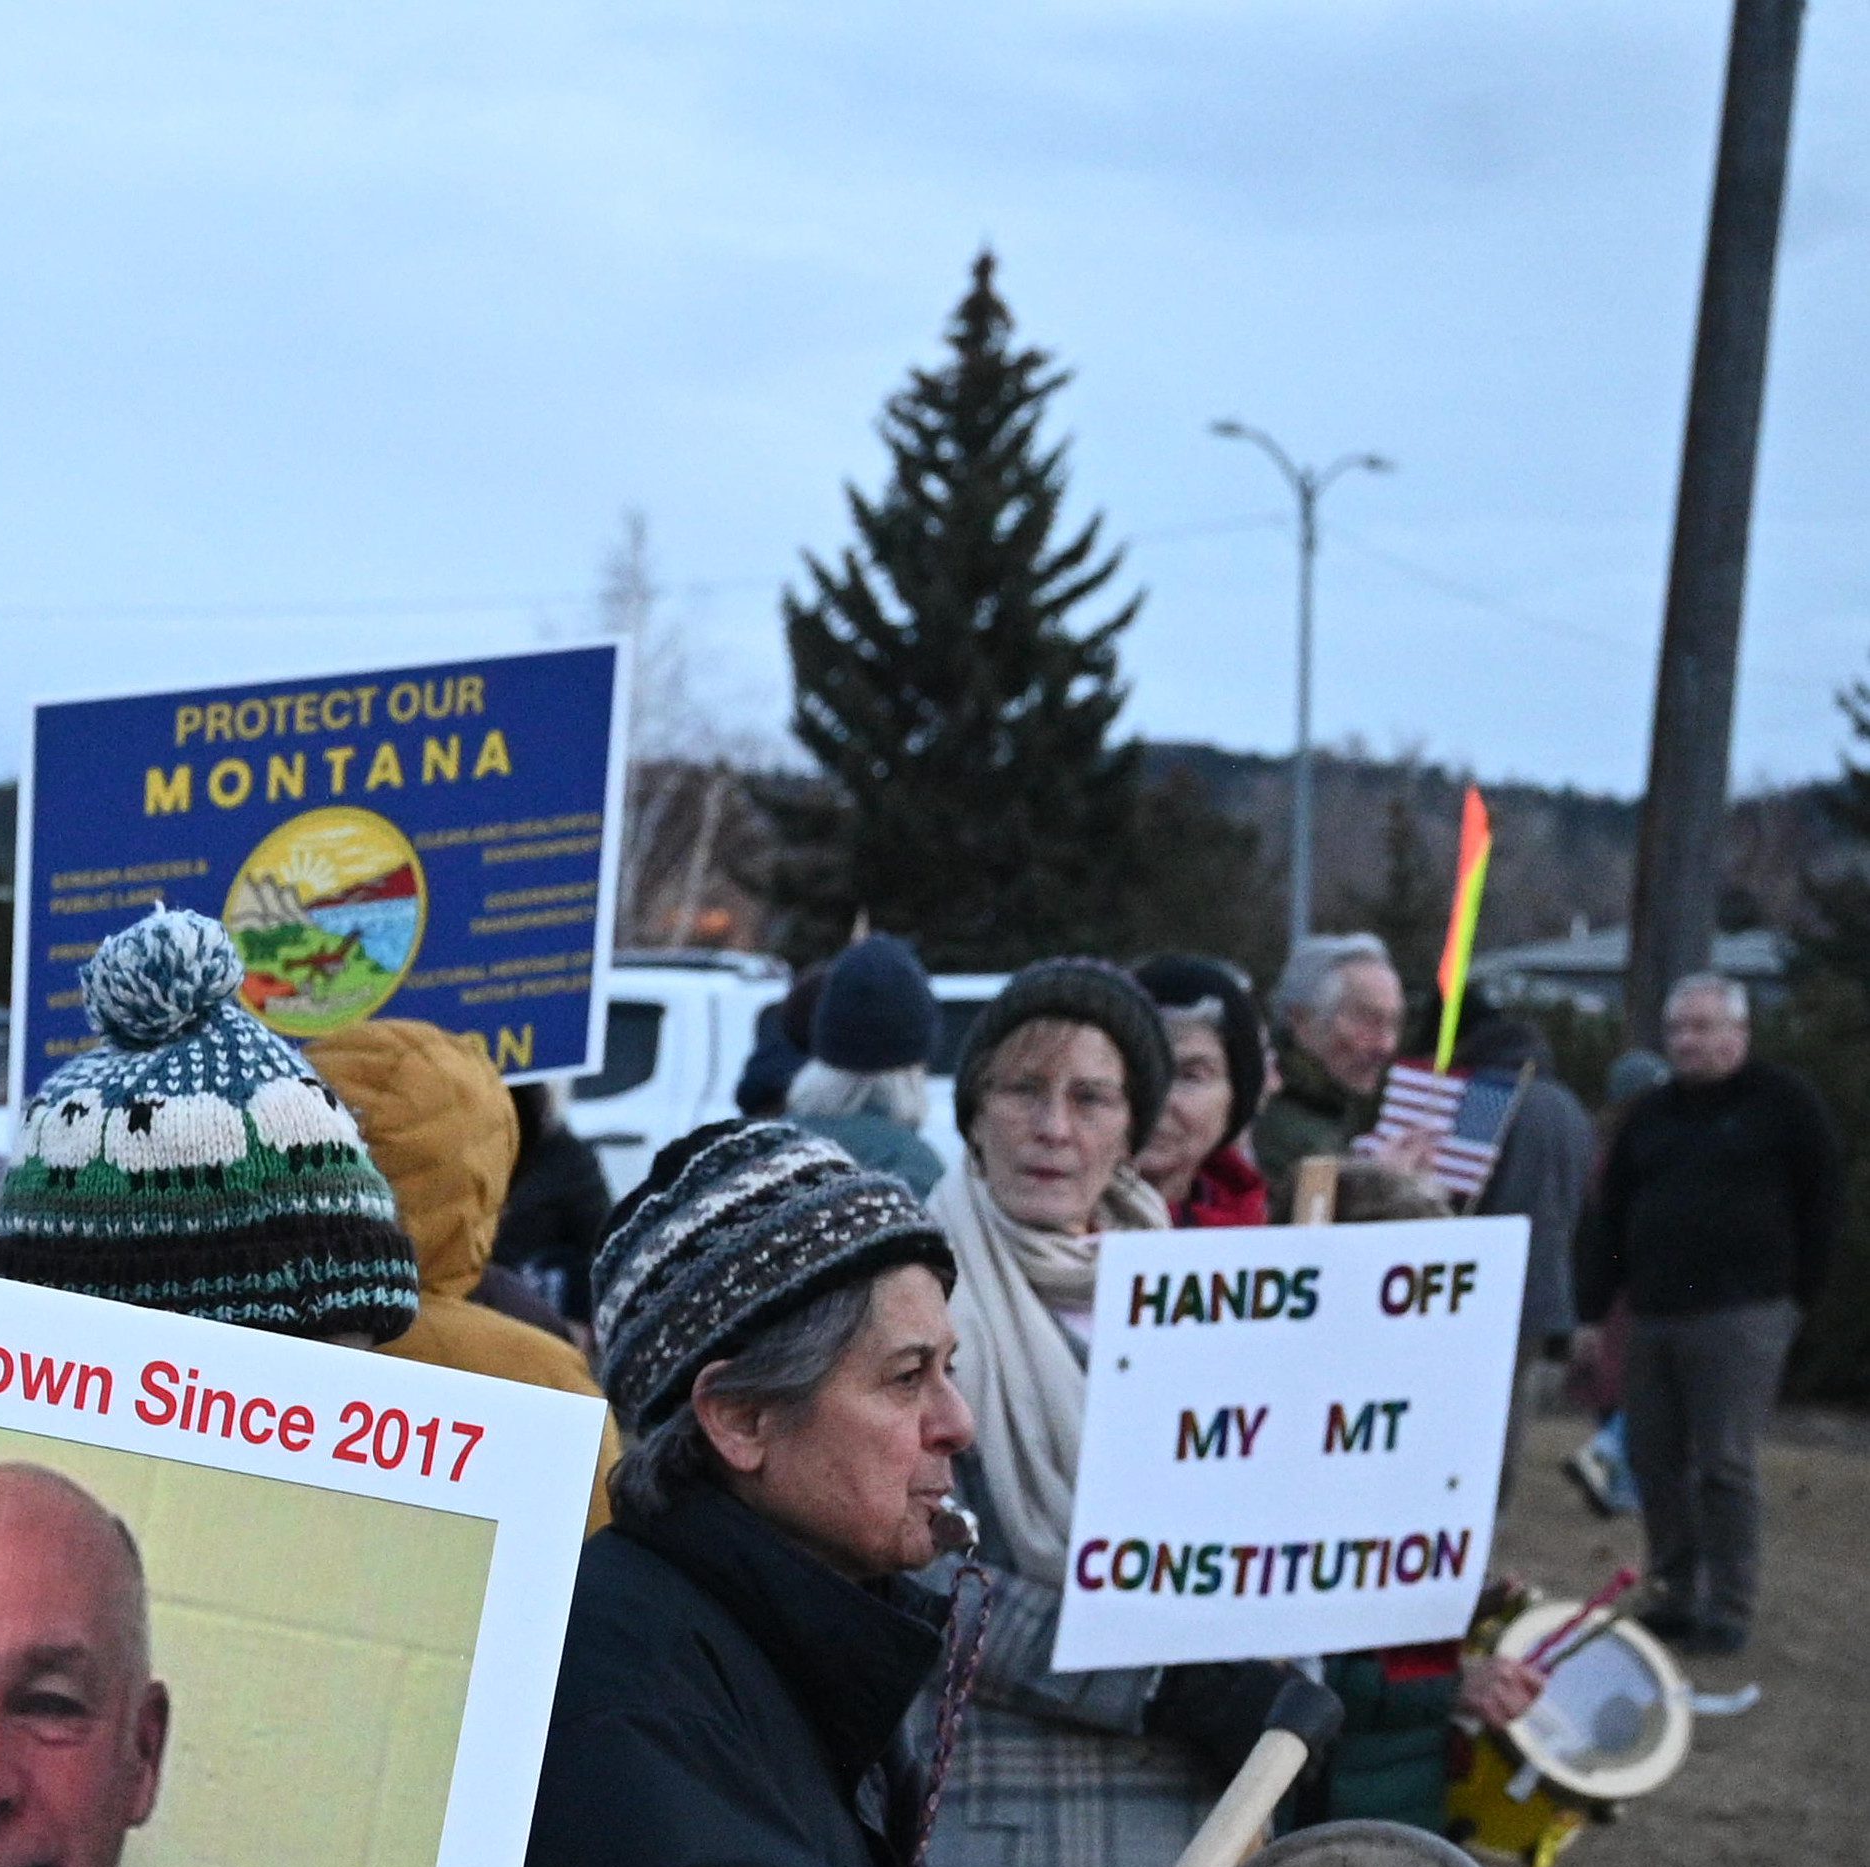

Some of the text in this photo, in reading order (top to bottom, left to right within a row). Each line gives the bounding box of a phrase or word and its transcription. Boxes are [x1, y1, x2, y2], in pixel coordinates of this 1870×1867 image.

[174, 676, 485, 747] PROTECT OUR
[144, 730, 513, 815] MONTANA
[1127, 1261, 1478, 1327] HANDS OFF
[135, 1360, 316, 1453] Since
[332, 1400, 486, 1483] 2017
[1175, 1400, 1410, 1461] MY MT
[1074, 1528, 1472, 1597] CONSTITUTION
